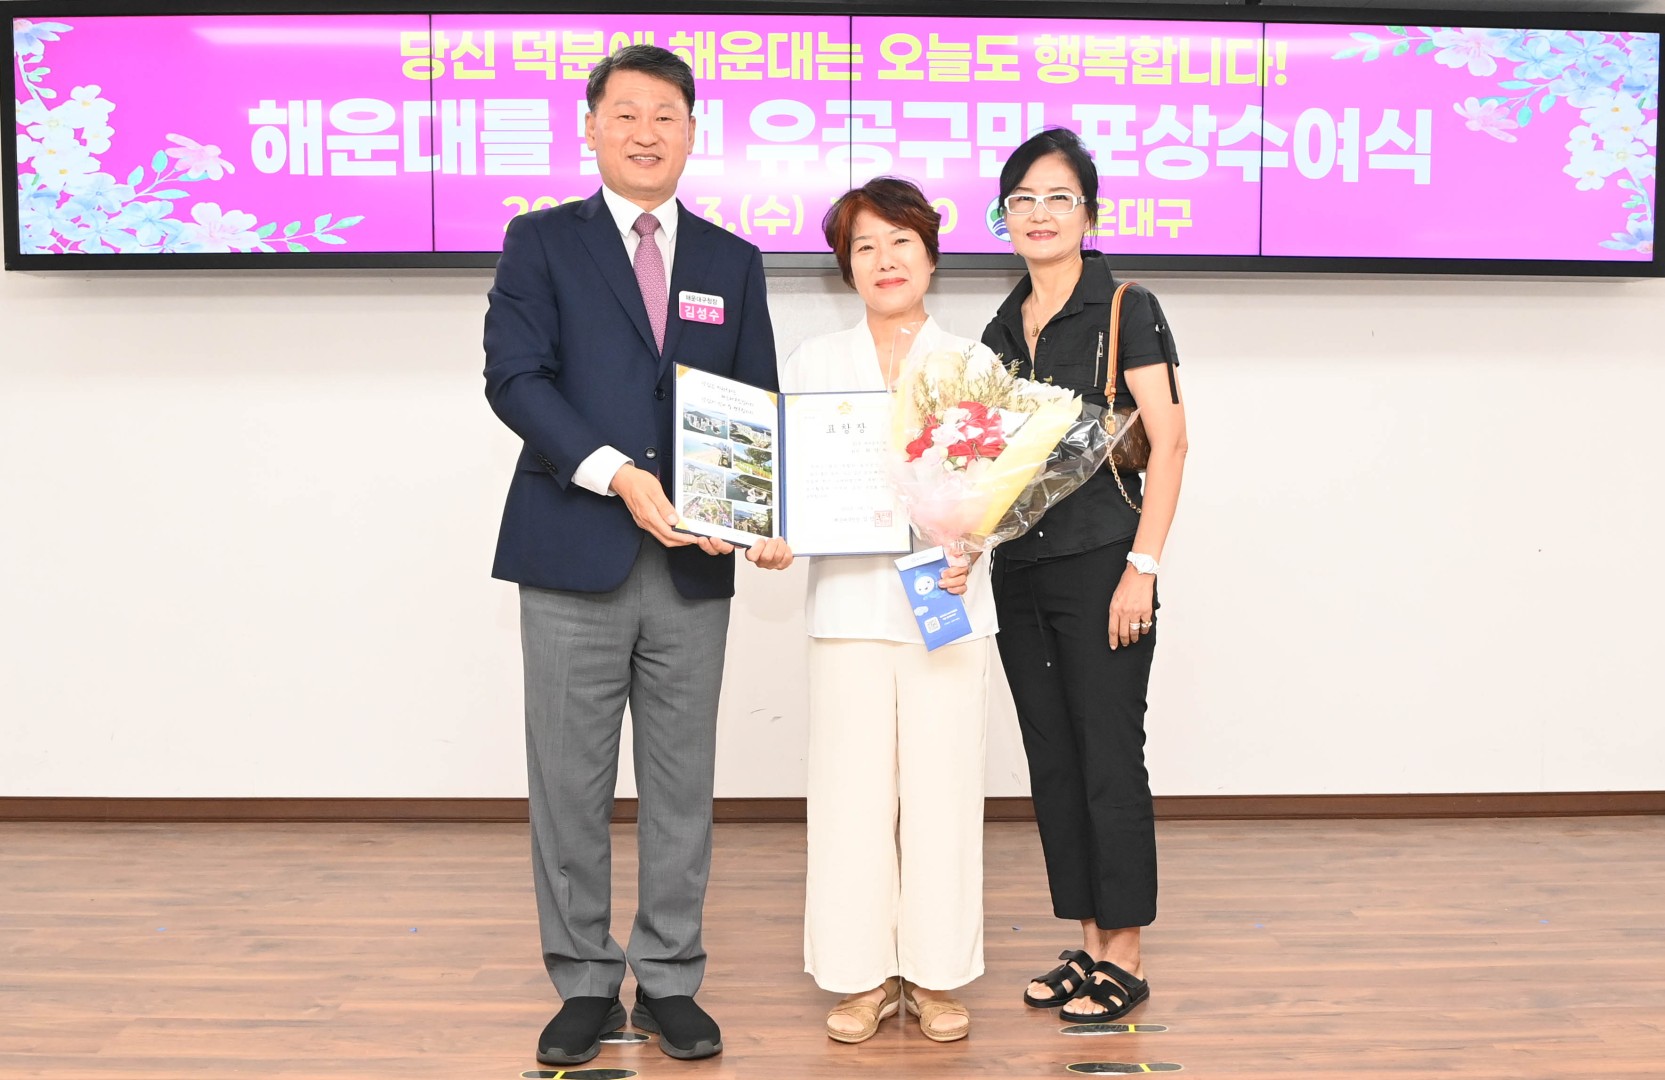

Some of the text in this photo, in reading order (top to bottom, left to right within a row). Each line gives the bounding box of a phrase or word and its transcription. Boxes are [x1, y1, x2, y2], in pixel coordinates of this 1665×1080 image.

[400, 30, 496, 80] 당신
[668, 30, 864, 81] 해운대는
[878, 33, 1021, 83] 오늘도
[1034, 35, 1288, 88] 행복합니다!
[248, 97, 553, 177] 해운대를
[746, 99, 1045, 179] 유공구민
[1071, 103, 1433, 186] 포상수여식
[684, 305, 720, 322] 김성수
